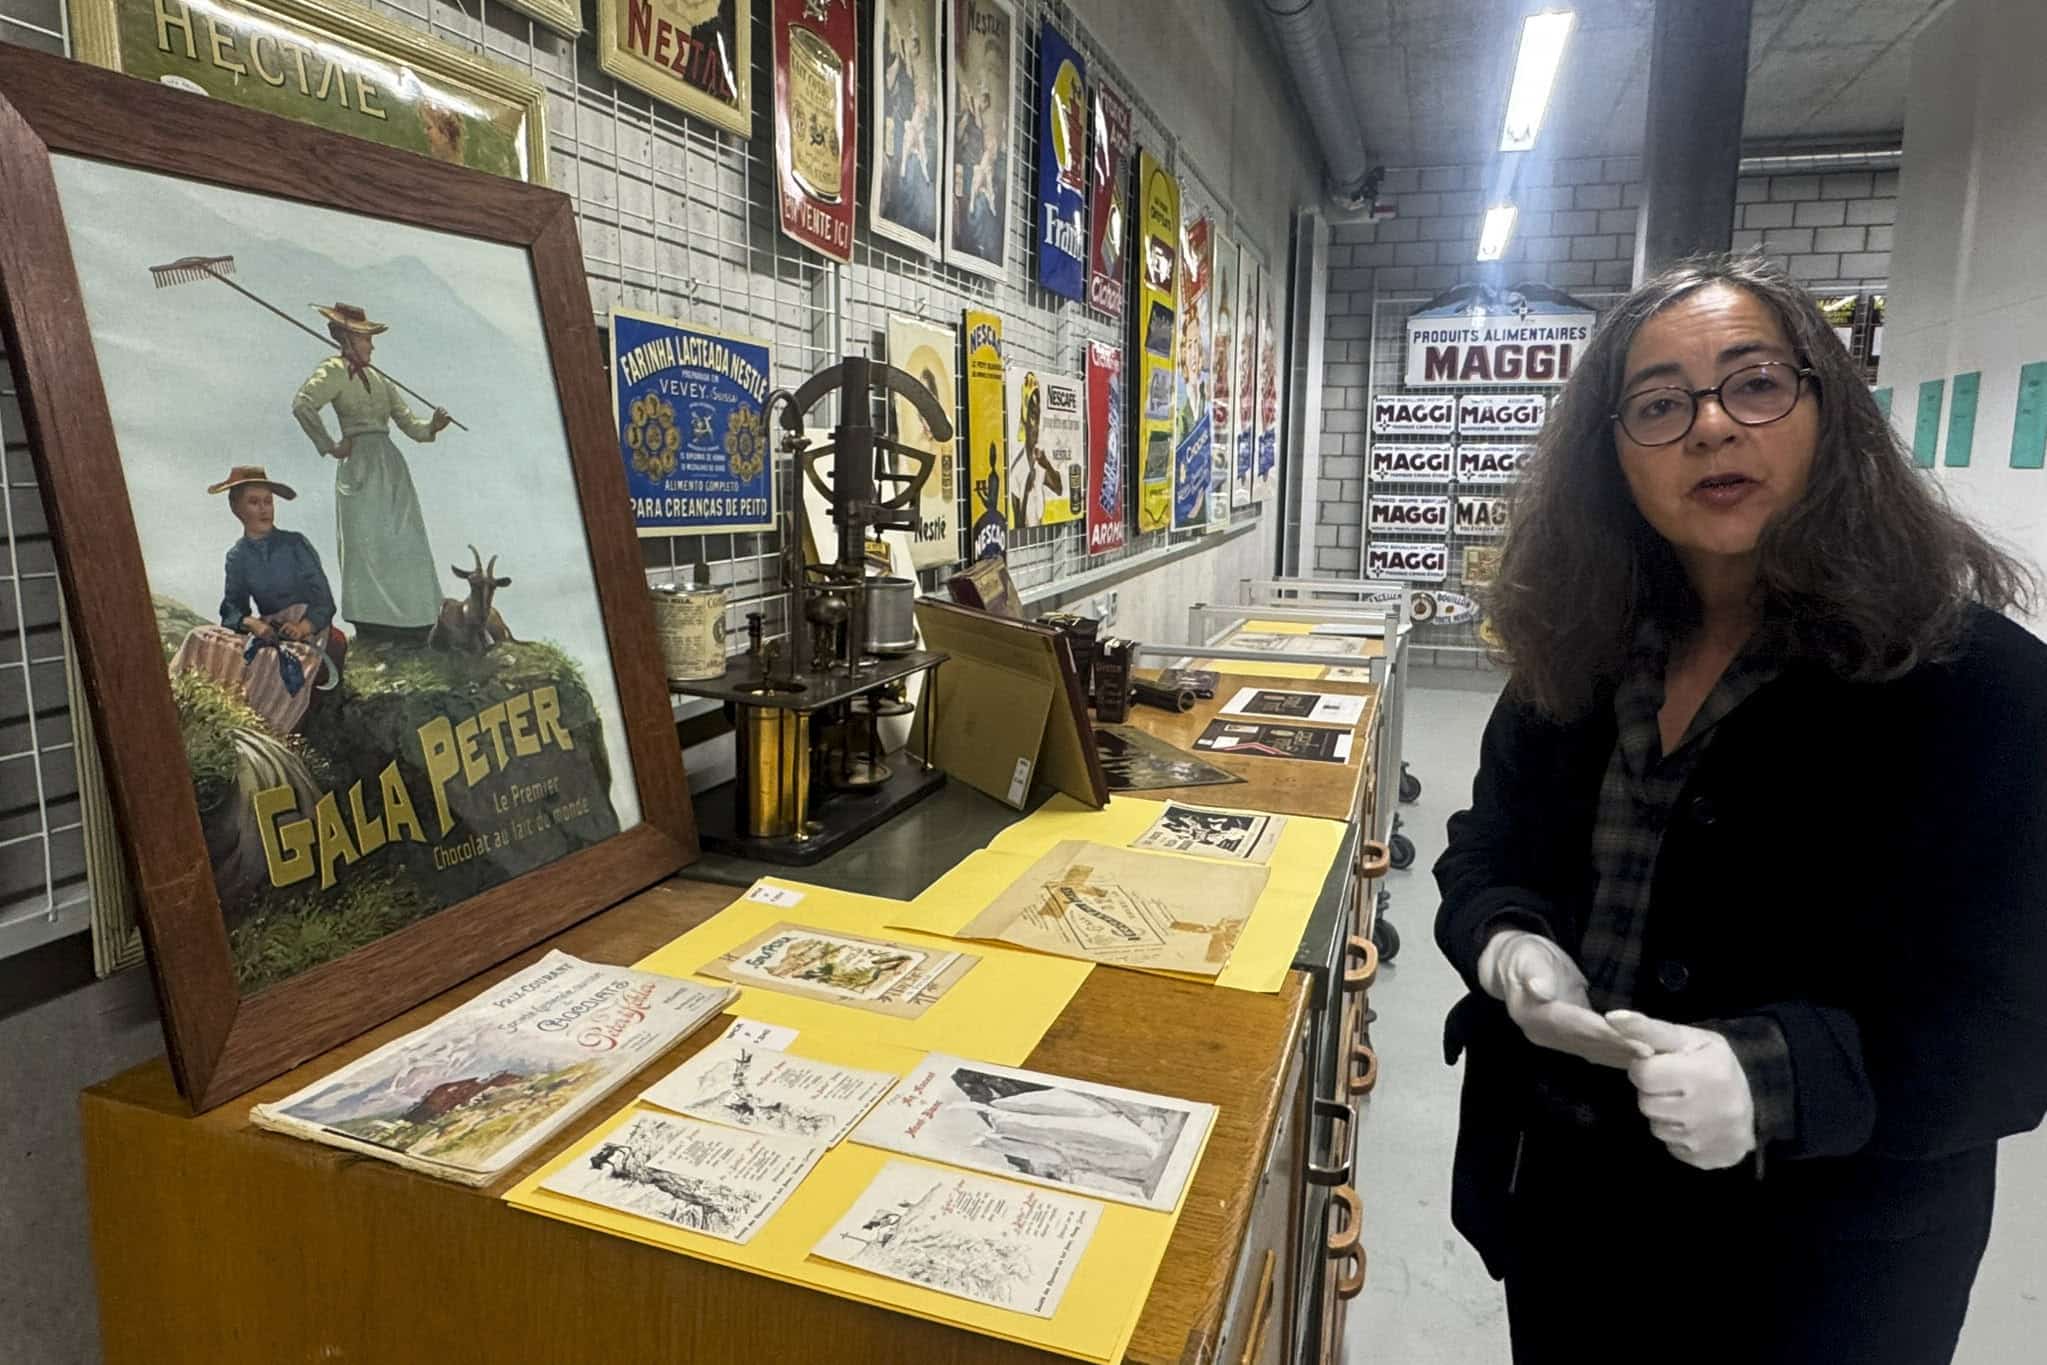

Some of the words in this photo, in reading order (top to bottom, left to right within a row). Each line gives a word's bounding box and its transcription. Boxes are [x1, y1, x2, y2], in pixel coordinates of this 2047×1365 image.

[801, 201, 832, 240] VENTE
[834, 217, 849, 248] ICI
[1413, 329, 1479, 344] PRODUITS
[1484, 326, 1587, 342] ALIMENTAIRES
[620, 336, 676, 387] FARINHA
[675, 335, 729, 376] LACTEADA
[1425, 344, 1573, 381] MAGGI
[1376, 404, 1452, 423] MAGGI
[1374, 453, 1450, 471] MAGGI
[664, 480, 703, 492] ALIMENTO
[630, 497, 662, 518] PARA
[664, 497, 723, 518] CREANÇAS
[725, 497, 738, 516] DE
[740, 497, 767, 517] PEITO
[1372, 505, 1446, 525] MAGGI
[1369, 551, 1445, 571] MAGGI
[254, 758, 427, 890] GALA
[417, 685, 574, 838] PETER
[493, 791, 510, 814] Le
[510, 775, 559, 807] Premier
[433, 832, 491, 872] Chocolat
[493, 830, 510, 849] au
[512, 816, 534, 841] lait
[552, 796, 590, 825] monde
